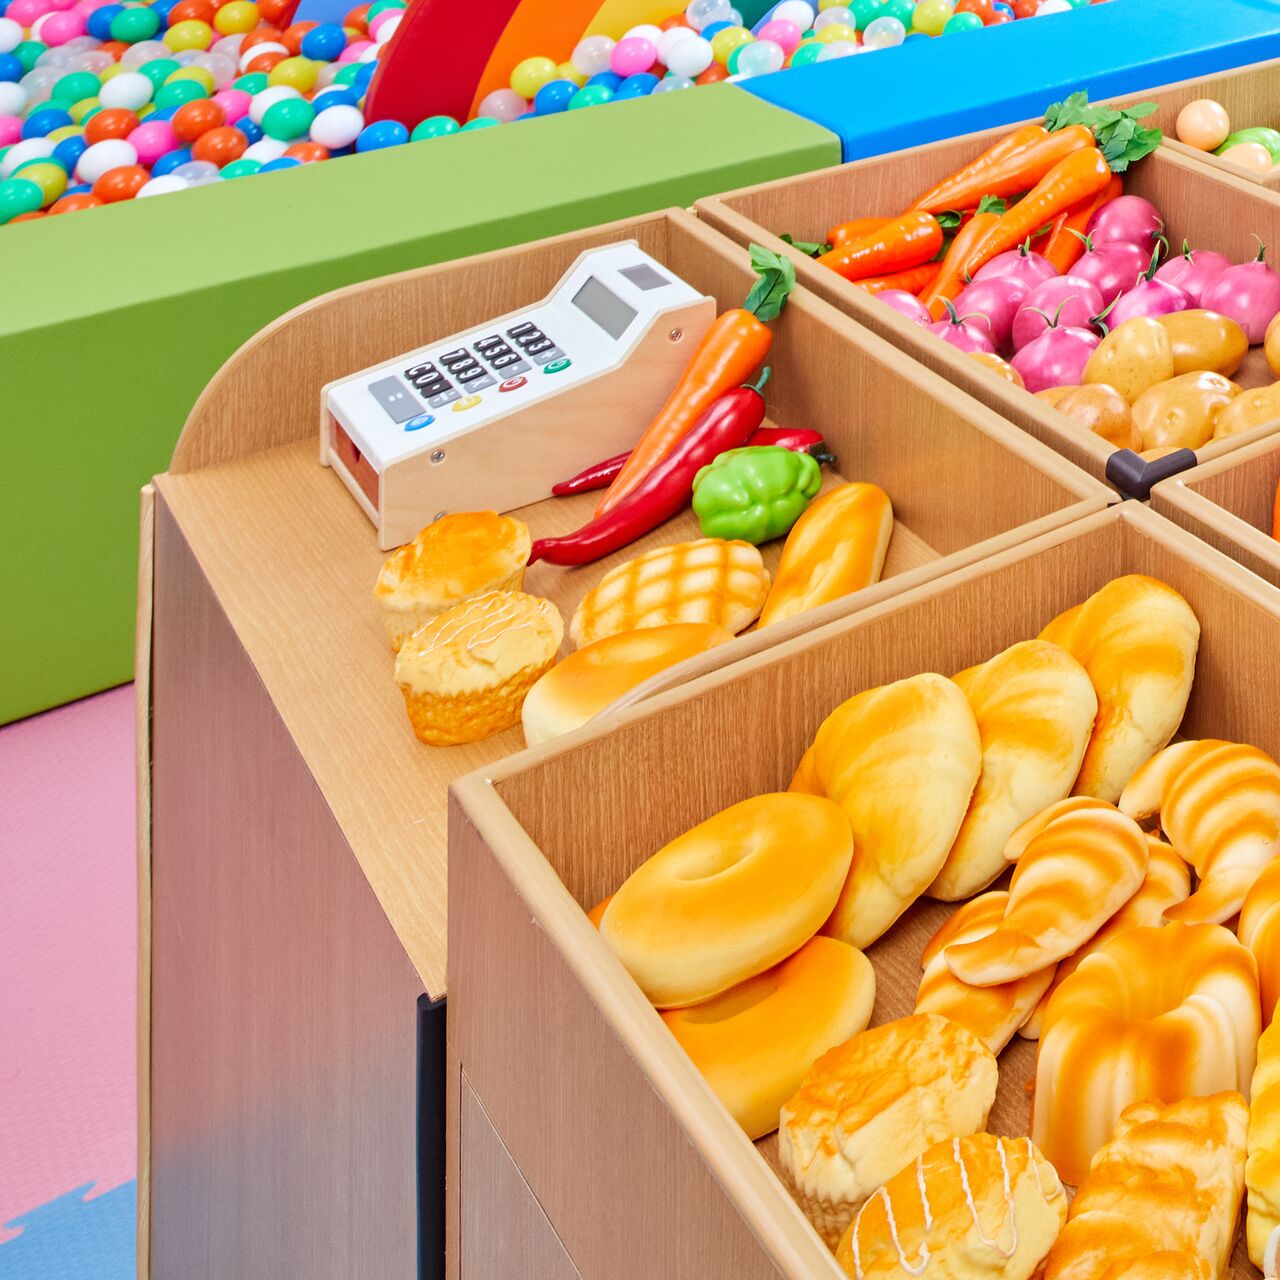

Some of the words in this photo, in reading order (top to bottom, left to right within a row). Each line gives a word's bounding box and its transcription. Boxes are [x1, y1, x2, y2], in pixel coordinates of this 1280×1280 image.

[511, 322, 533, 334] 1
[478, 336, 500, 348] 4
[518, 330, 542, 343] 2
[485, 344, 508, 357] 5
[528, 339, 551, 352] 3
[442, 349, 466, 360] 7
[494, 353, 518, 365] 6
[408, 363, 432, 375] C
[451, 358, 474, 370] 8
[459, 367, 482, 379] 9
